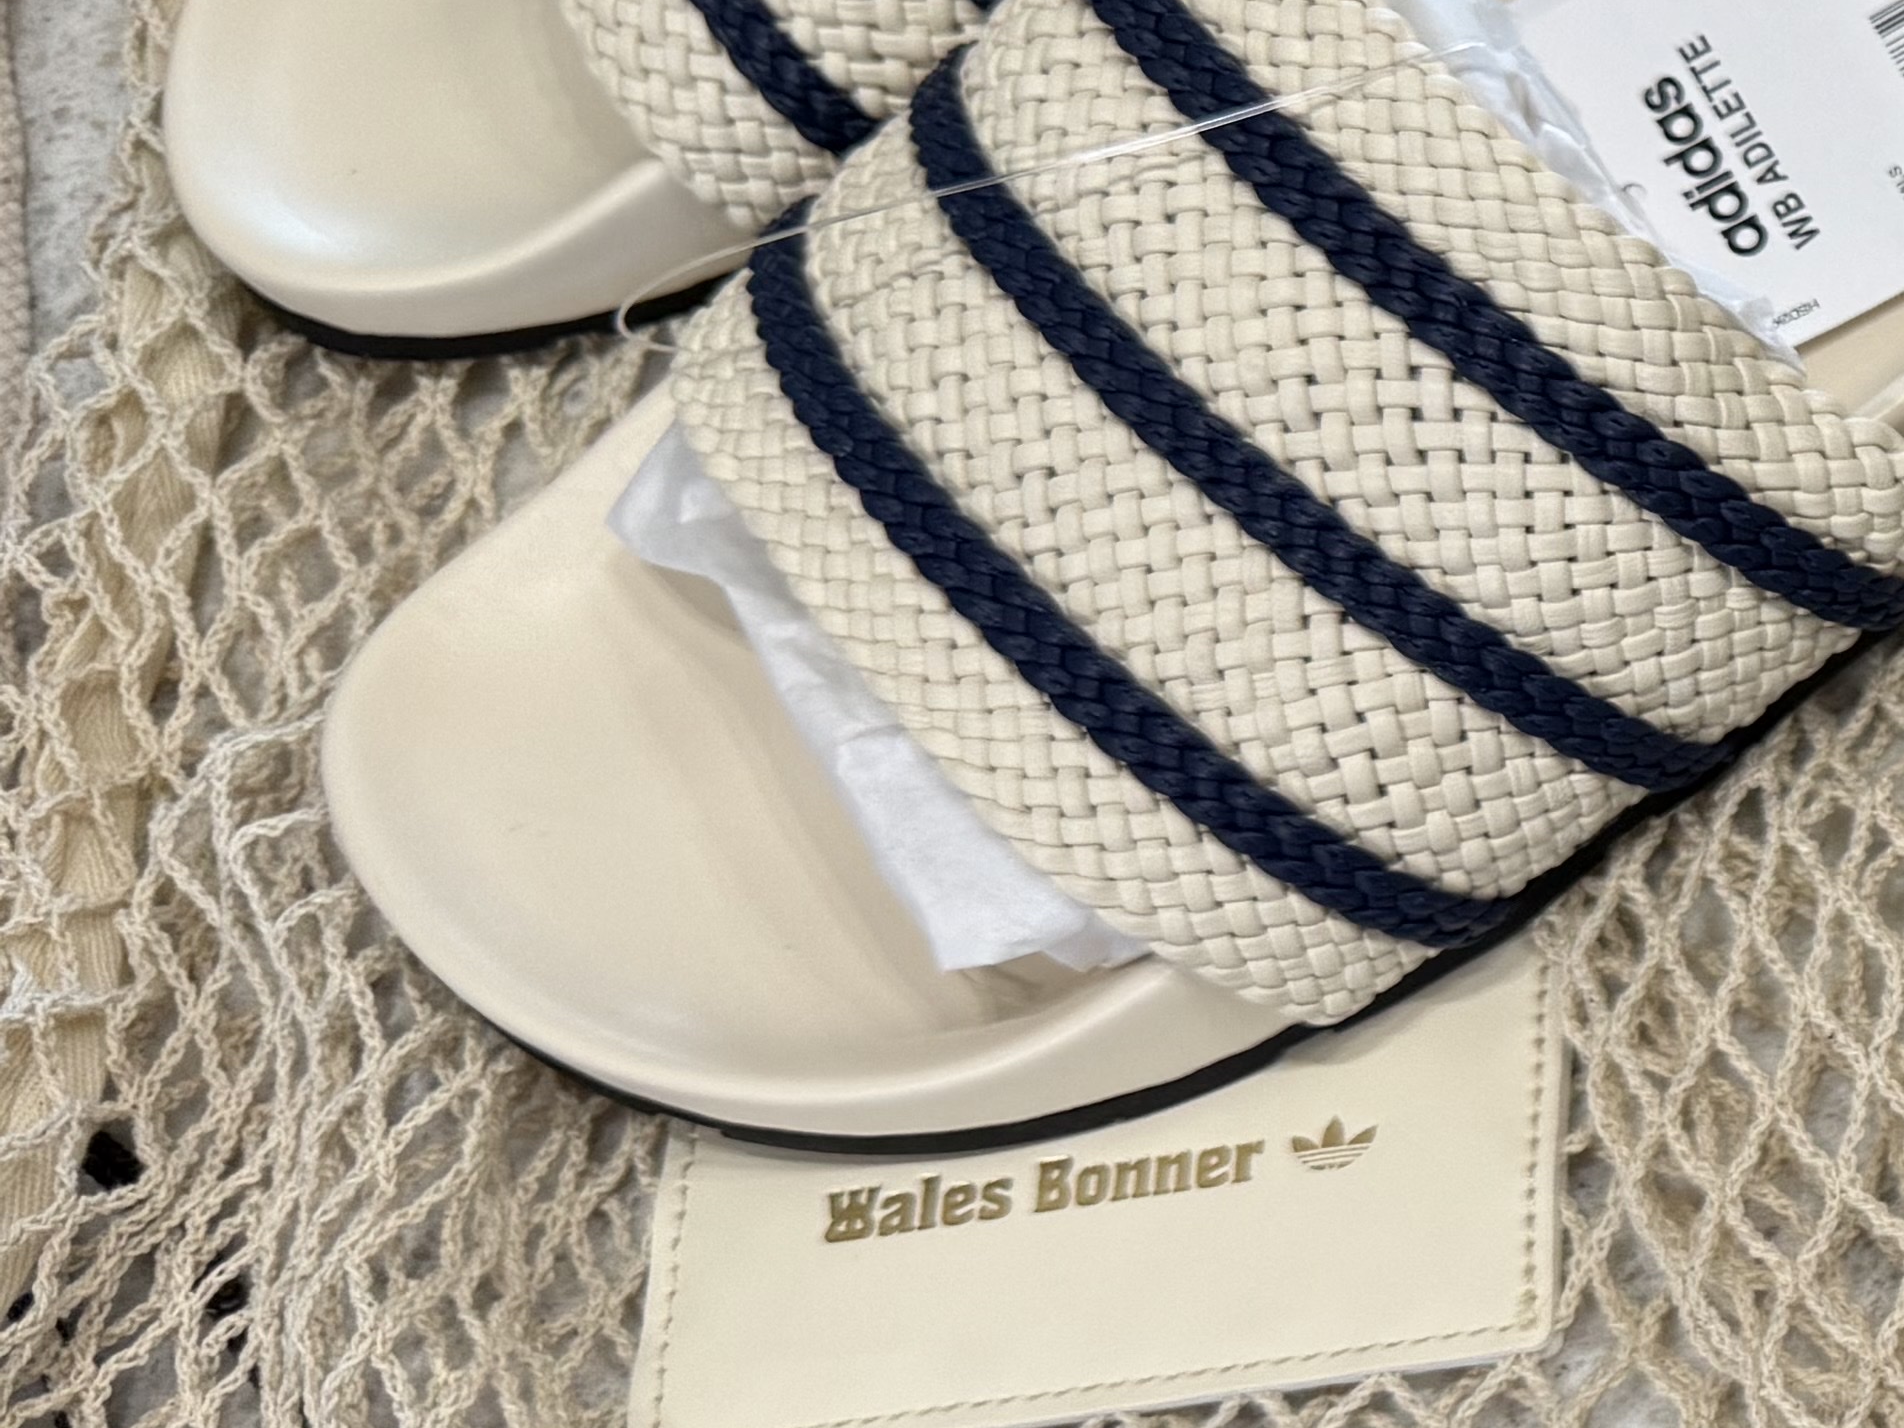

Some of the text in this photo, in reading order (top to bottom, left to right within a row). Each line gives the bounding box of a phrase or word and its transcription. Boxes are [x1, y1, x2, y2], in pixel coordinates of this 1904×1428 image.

[1643, 75, 1770, 258] adidas
[1677, 34, 1822, 251] WB ADILETTE
[824, 1137, 1266, 1244] Wales Bonner
